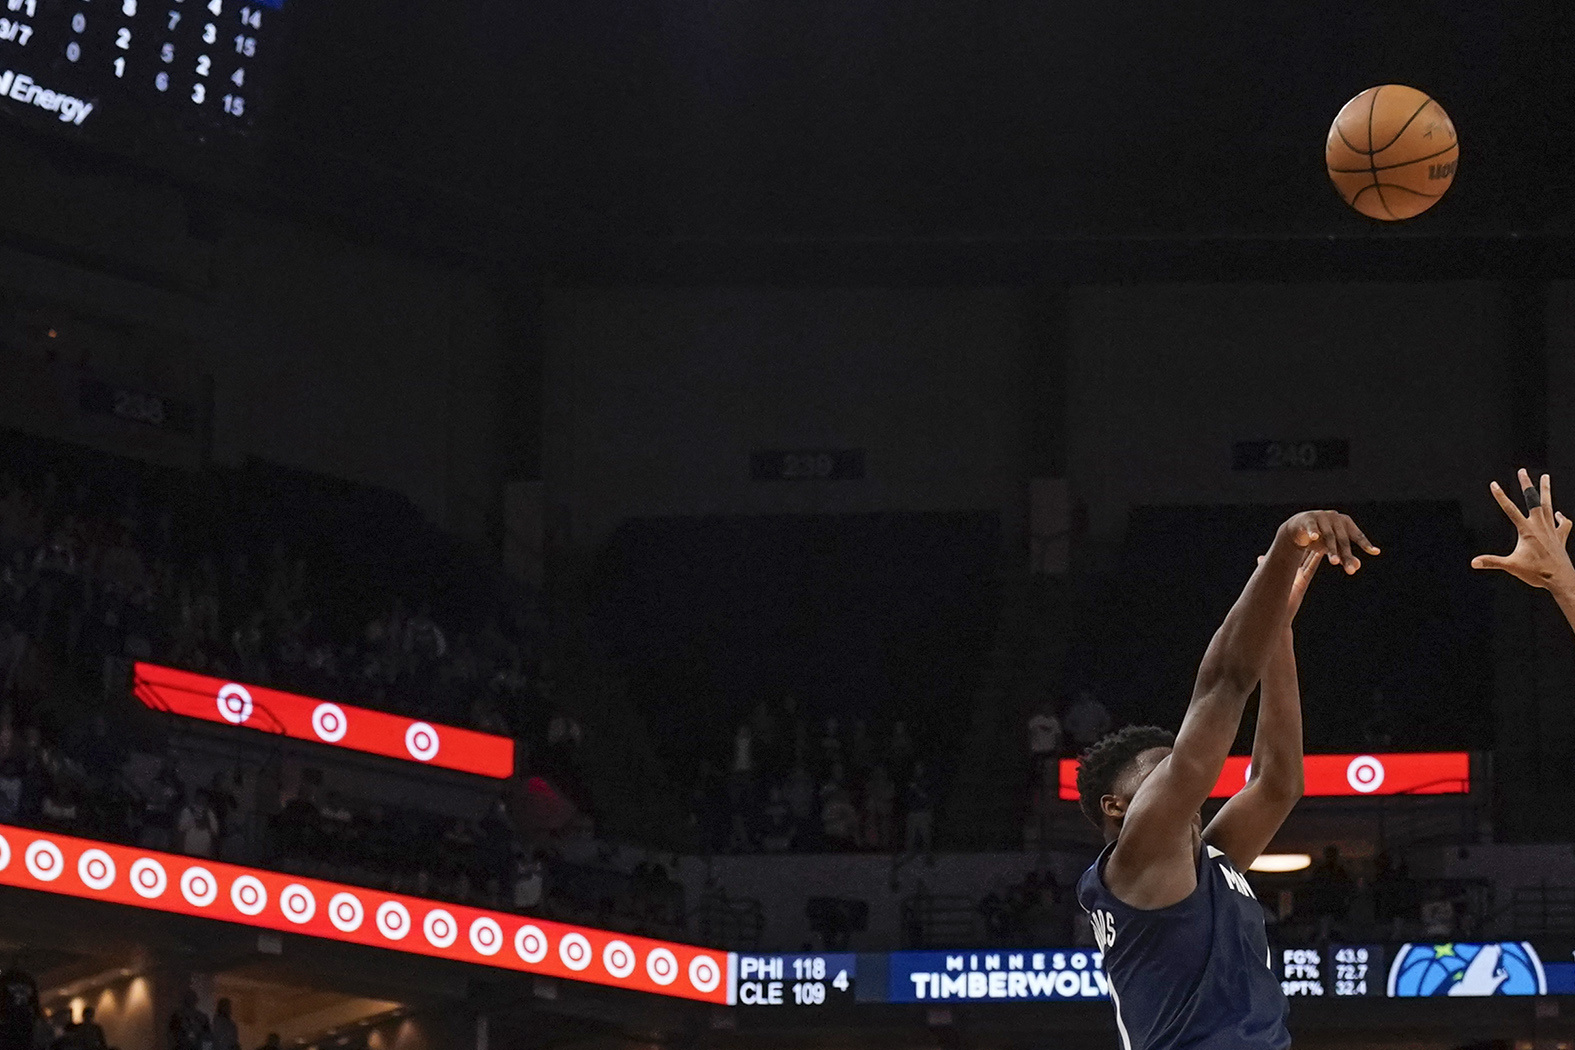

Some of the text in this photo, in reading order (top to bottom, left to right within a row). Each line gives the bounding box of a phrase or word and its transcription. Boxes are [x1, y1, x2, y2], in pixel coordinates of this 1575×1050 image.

[240, 6, 262, 30] 14
[202, 23, 217, 44] 3
[115, 27, 131, 49] 2
[196, 55, 211, 76] 2
[231, 67, 245, 87] 4
[113, 56, 126, 78] 1
[191, 83, 206, 104] 3
[9, 74, 94, 126] Energy
[740, 957, 826, 980] PHI 118
[832, 969, 849, 992] 4
[1284, 964, 1320, 979] FT%
[739, 981, 826, 1005] CLE 109
